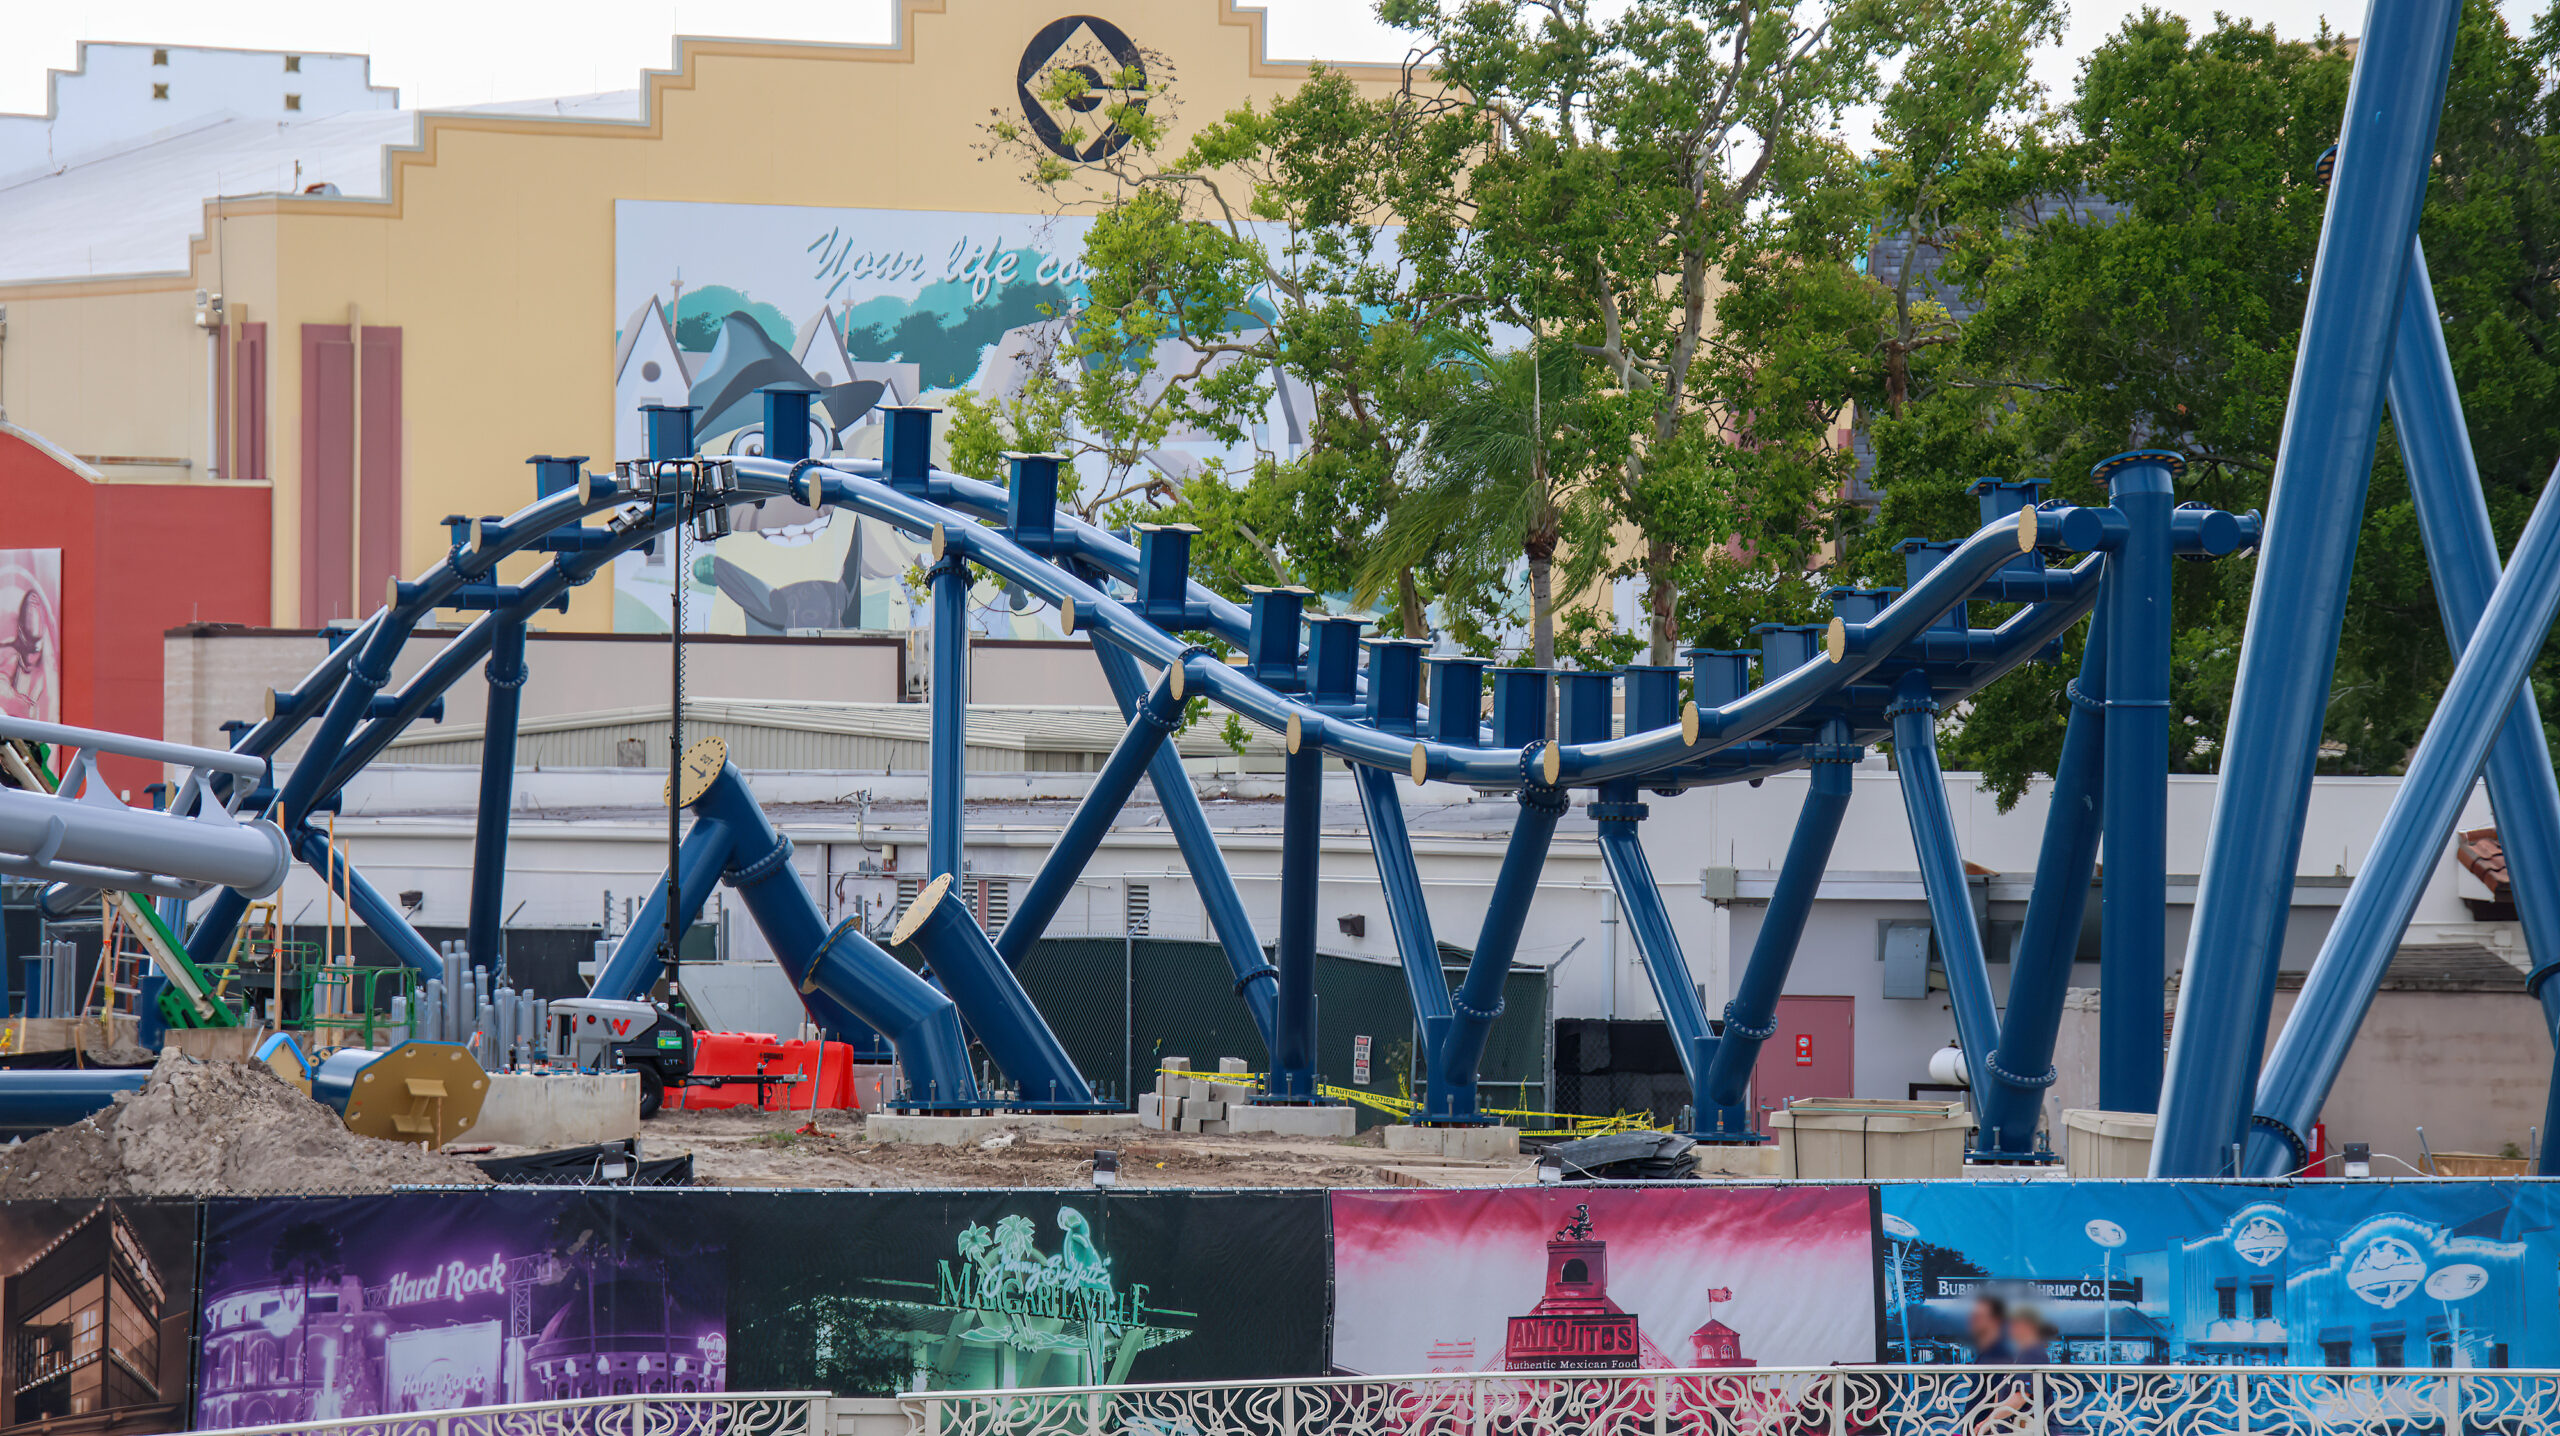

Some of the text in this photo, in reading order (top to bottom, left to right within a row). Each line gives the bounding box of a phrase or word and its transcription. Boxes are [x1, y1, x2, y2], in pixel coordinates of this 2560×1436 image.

[807, 225, 927, 299] Your
[947, 235, 1020, 304] life
[1330, 1087, 1360, 1098] CAUTION
[1365, 1094, 1396, 1105] CAUTION
[388, 1252, 507, 1307] Hard Rock
[938, 1259, 1151, 1327] MARGARITAVILLE
[1938, 1280, 1981, 1296] BUBB
[1511, 1319, 1633, 1353] ANTOJITOS
[1506, 1360, 1638, 1371] Authentic Mexican Food
